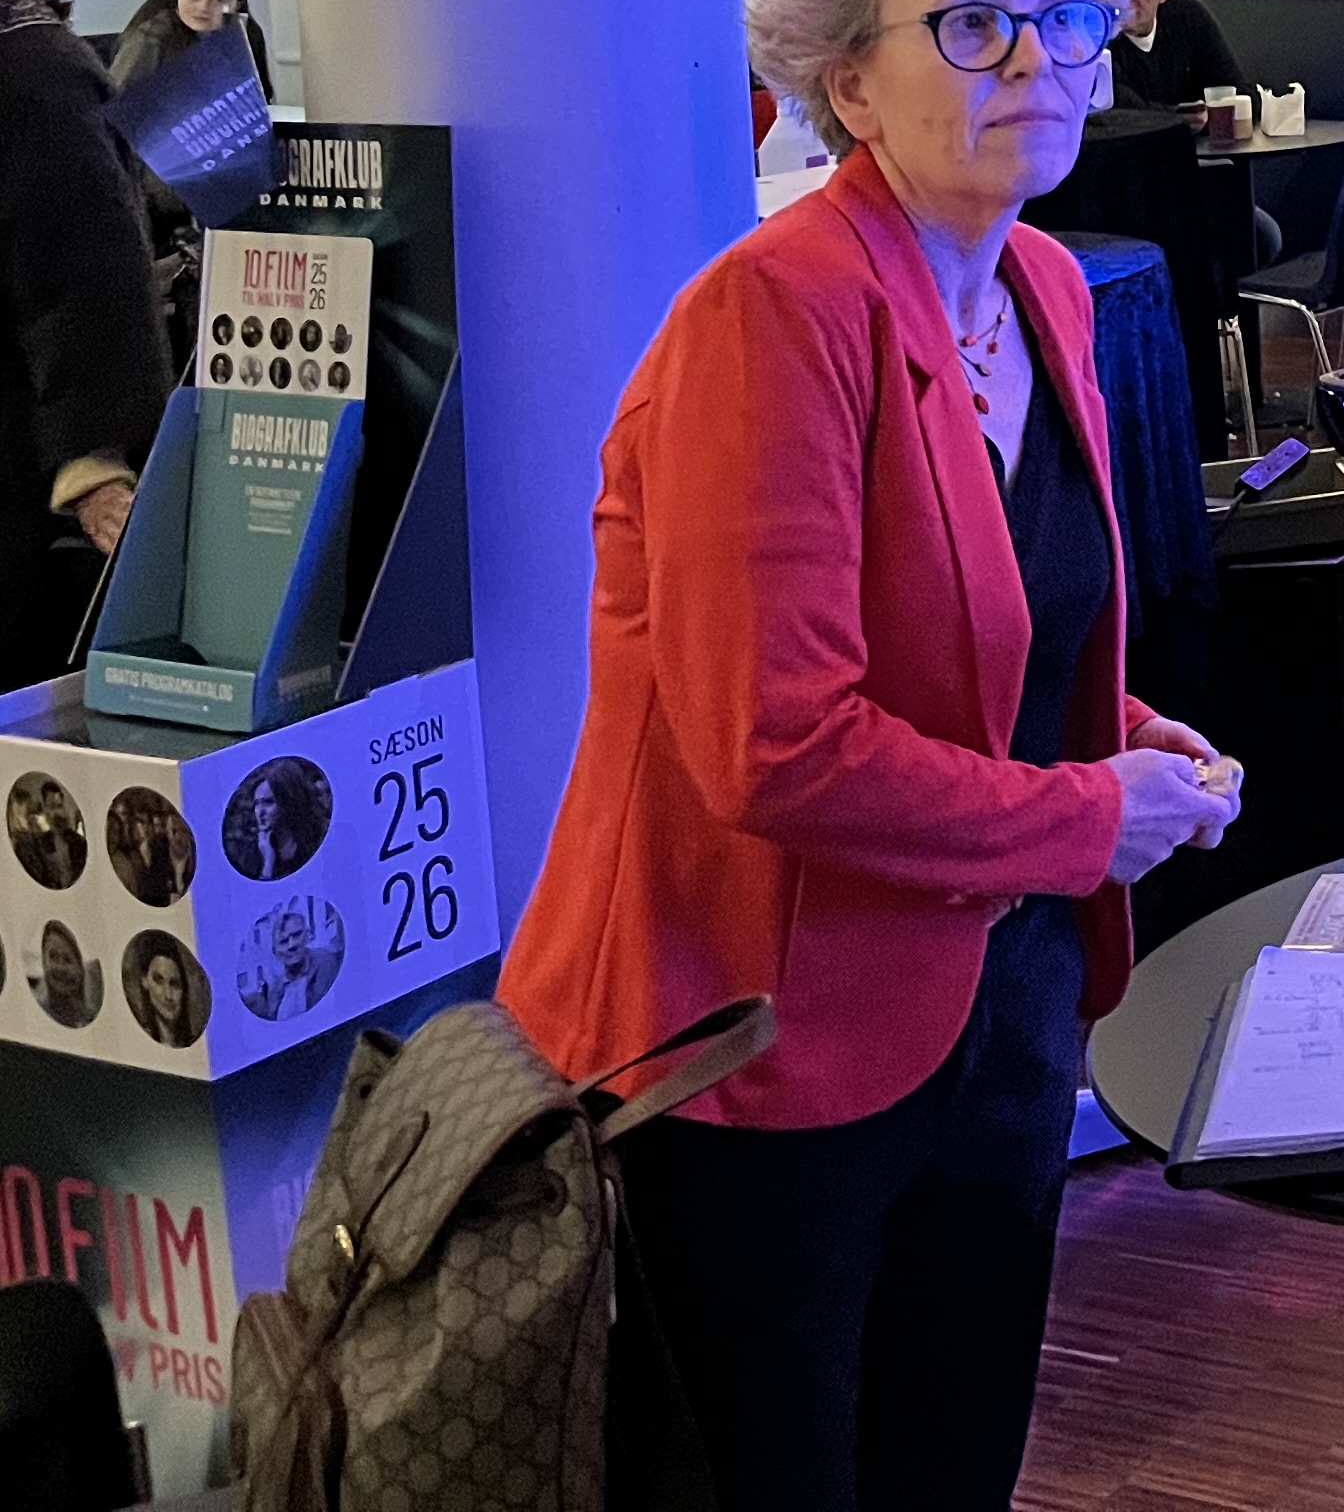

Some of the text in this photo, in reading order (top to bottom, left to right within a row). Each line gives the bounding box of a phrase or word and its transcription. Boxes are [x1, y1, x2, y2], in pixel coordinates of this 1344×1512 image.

[259, 193, 383, 210] DANMARK
[311, 263, 327, 285] 25
[309, 288, 326, 310] 26
[231, 413, 329, 457] BIOGRAFKLUB
[229, 455, 325, 473] DANMARK
[369, 714, 444, 765] SÆSON
[374, 753, 449, 862] 25
[382, 854, 458, 962] 26
[150, 1341, 227, 1408] PRIS
